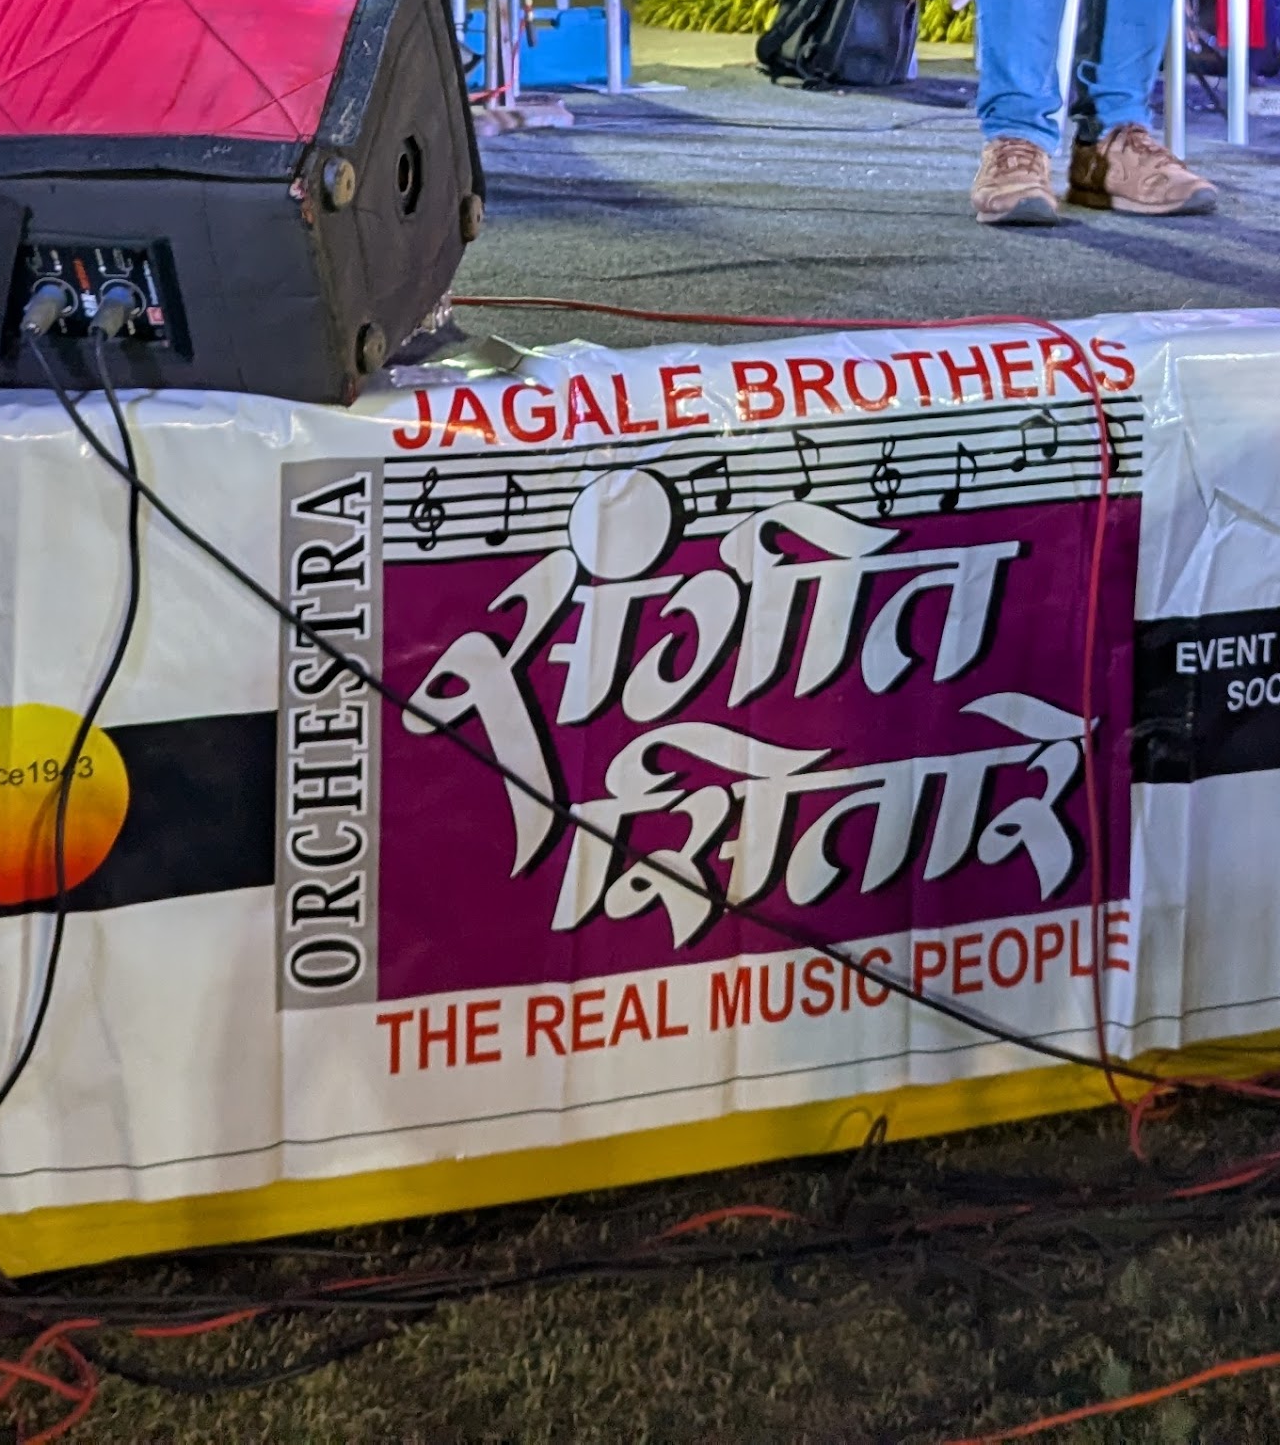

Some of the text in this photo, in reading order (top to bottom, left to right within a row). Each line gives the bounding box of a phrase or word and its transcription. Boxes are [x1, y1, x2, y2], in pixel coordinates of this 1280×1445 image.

[392, 336, 1136, 451] JAGALE BROTHERS
[1175, 631, 1277, 674] EVENT
[284, 471, 372, 994] ORCHESTRA
[376, 910, 1131, 1075] THE REAL MUSIC PEOPLE
